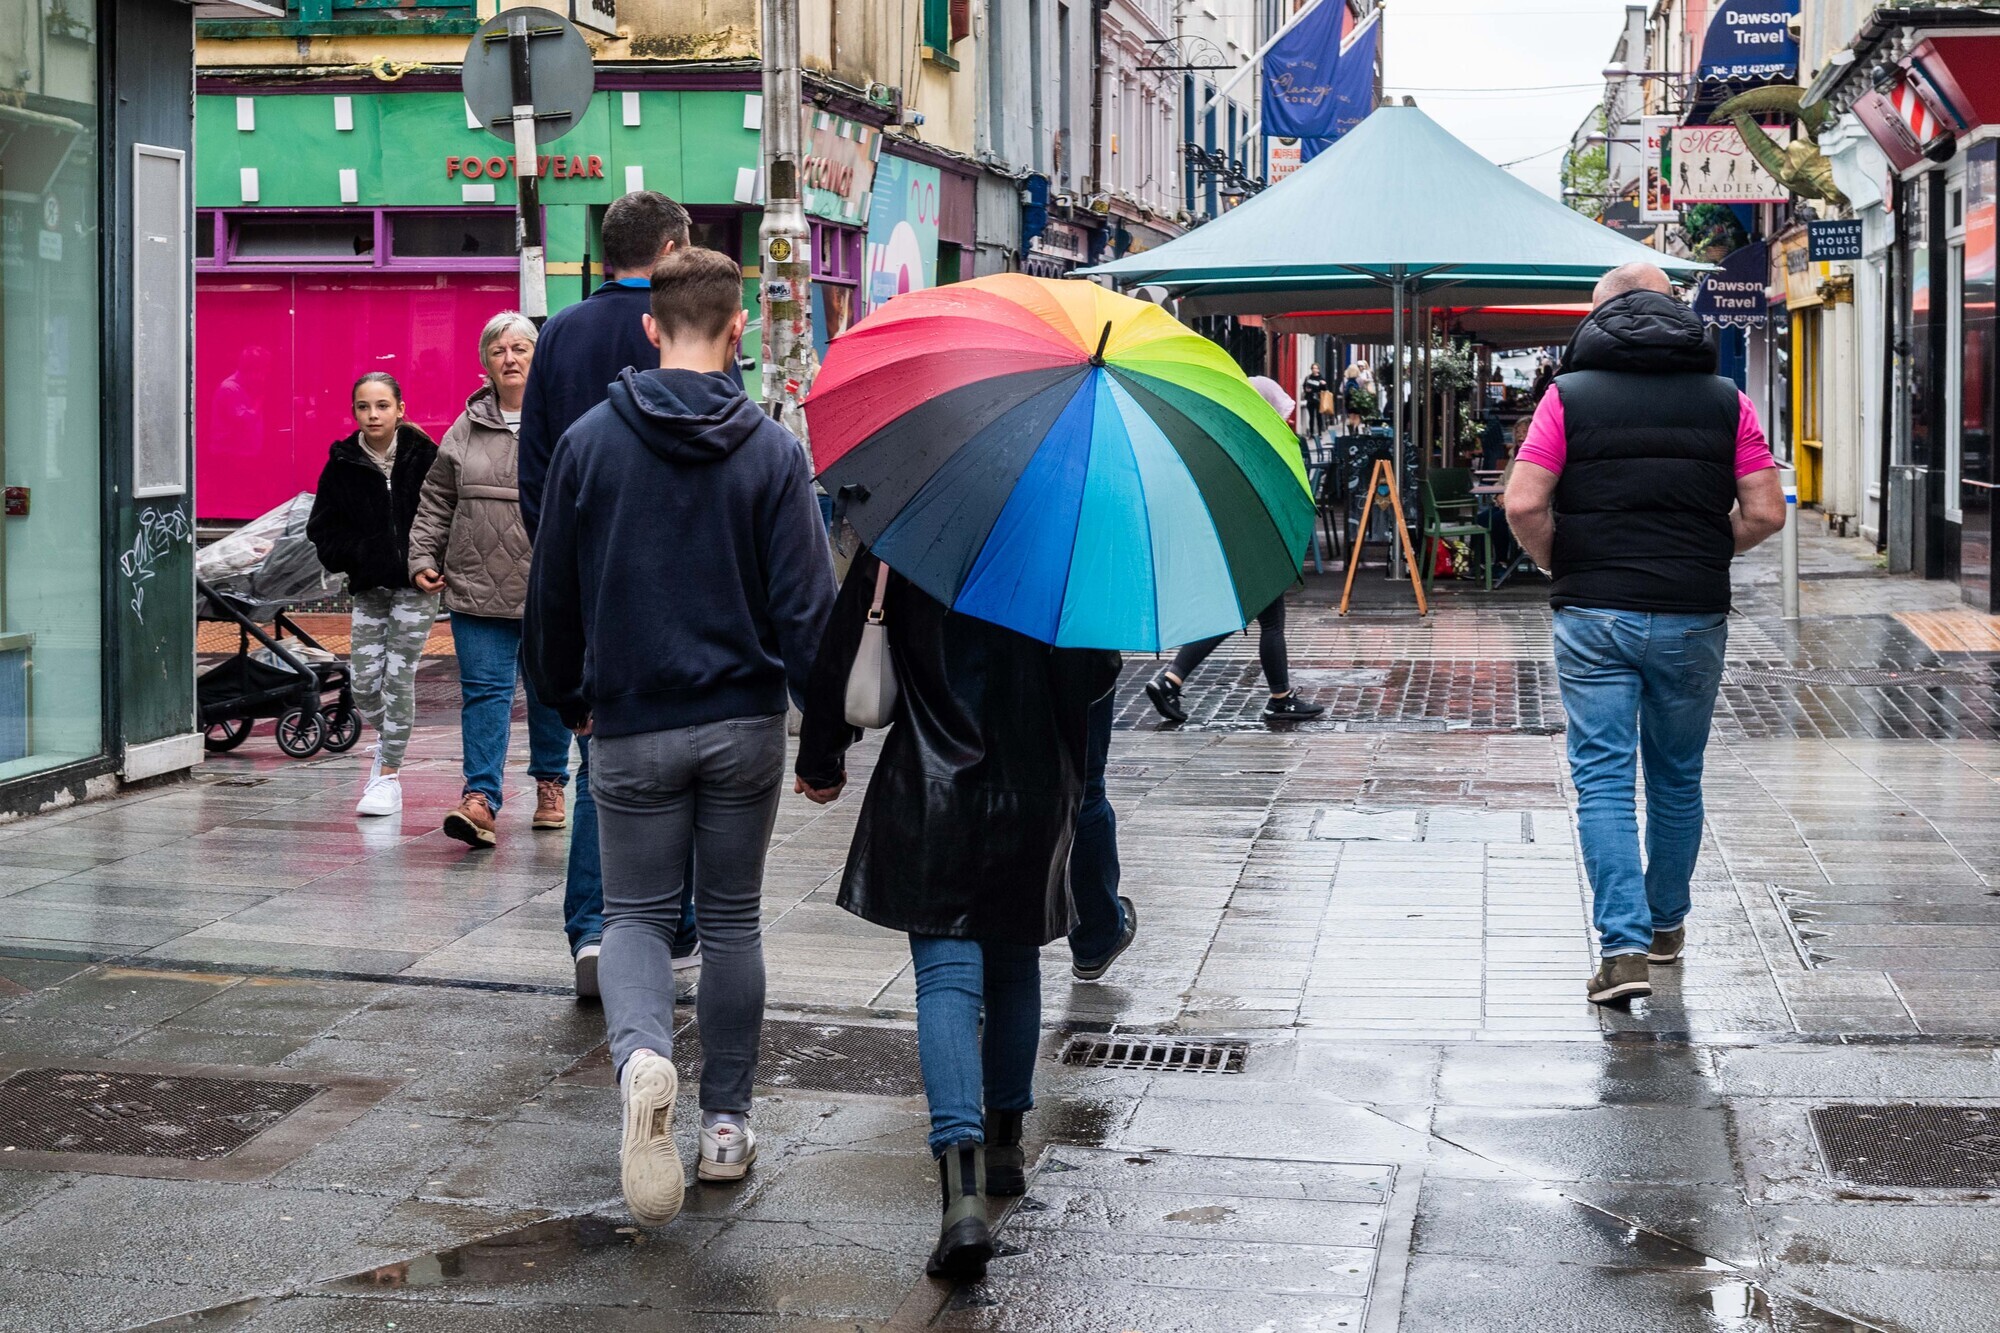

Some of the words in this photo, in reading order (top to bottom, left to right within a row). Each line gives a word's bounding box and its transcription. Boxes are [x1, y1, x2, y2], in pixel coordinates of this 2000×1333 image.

[1726, 10, 1792, 25] Dawson
[1733, 29, 1784, 44] Travel
[1711, 65, 1728, 74] Tel:
[1731, 65, 1747, 73] 021
[446, 155, 604, 179] FOOTWEAR
[1699, 184, 1763, 192] LADIES
[1812, 226, 1861, 236] SUMMER
[1818, 236, 1857, 245] HOUSE
[1815, 246, 1859, 256] STUDIO
[1707, 279, 1763, 291] Dawson
[1713, 295, 1756, 308] Travel
[1702, 314, 1716, 322] Tel:
